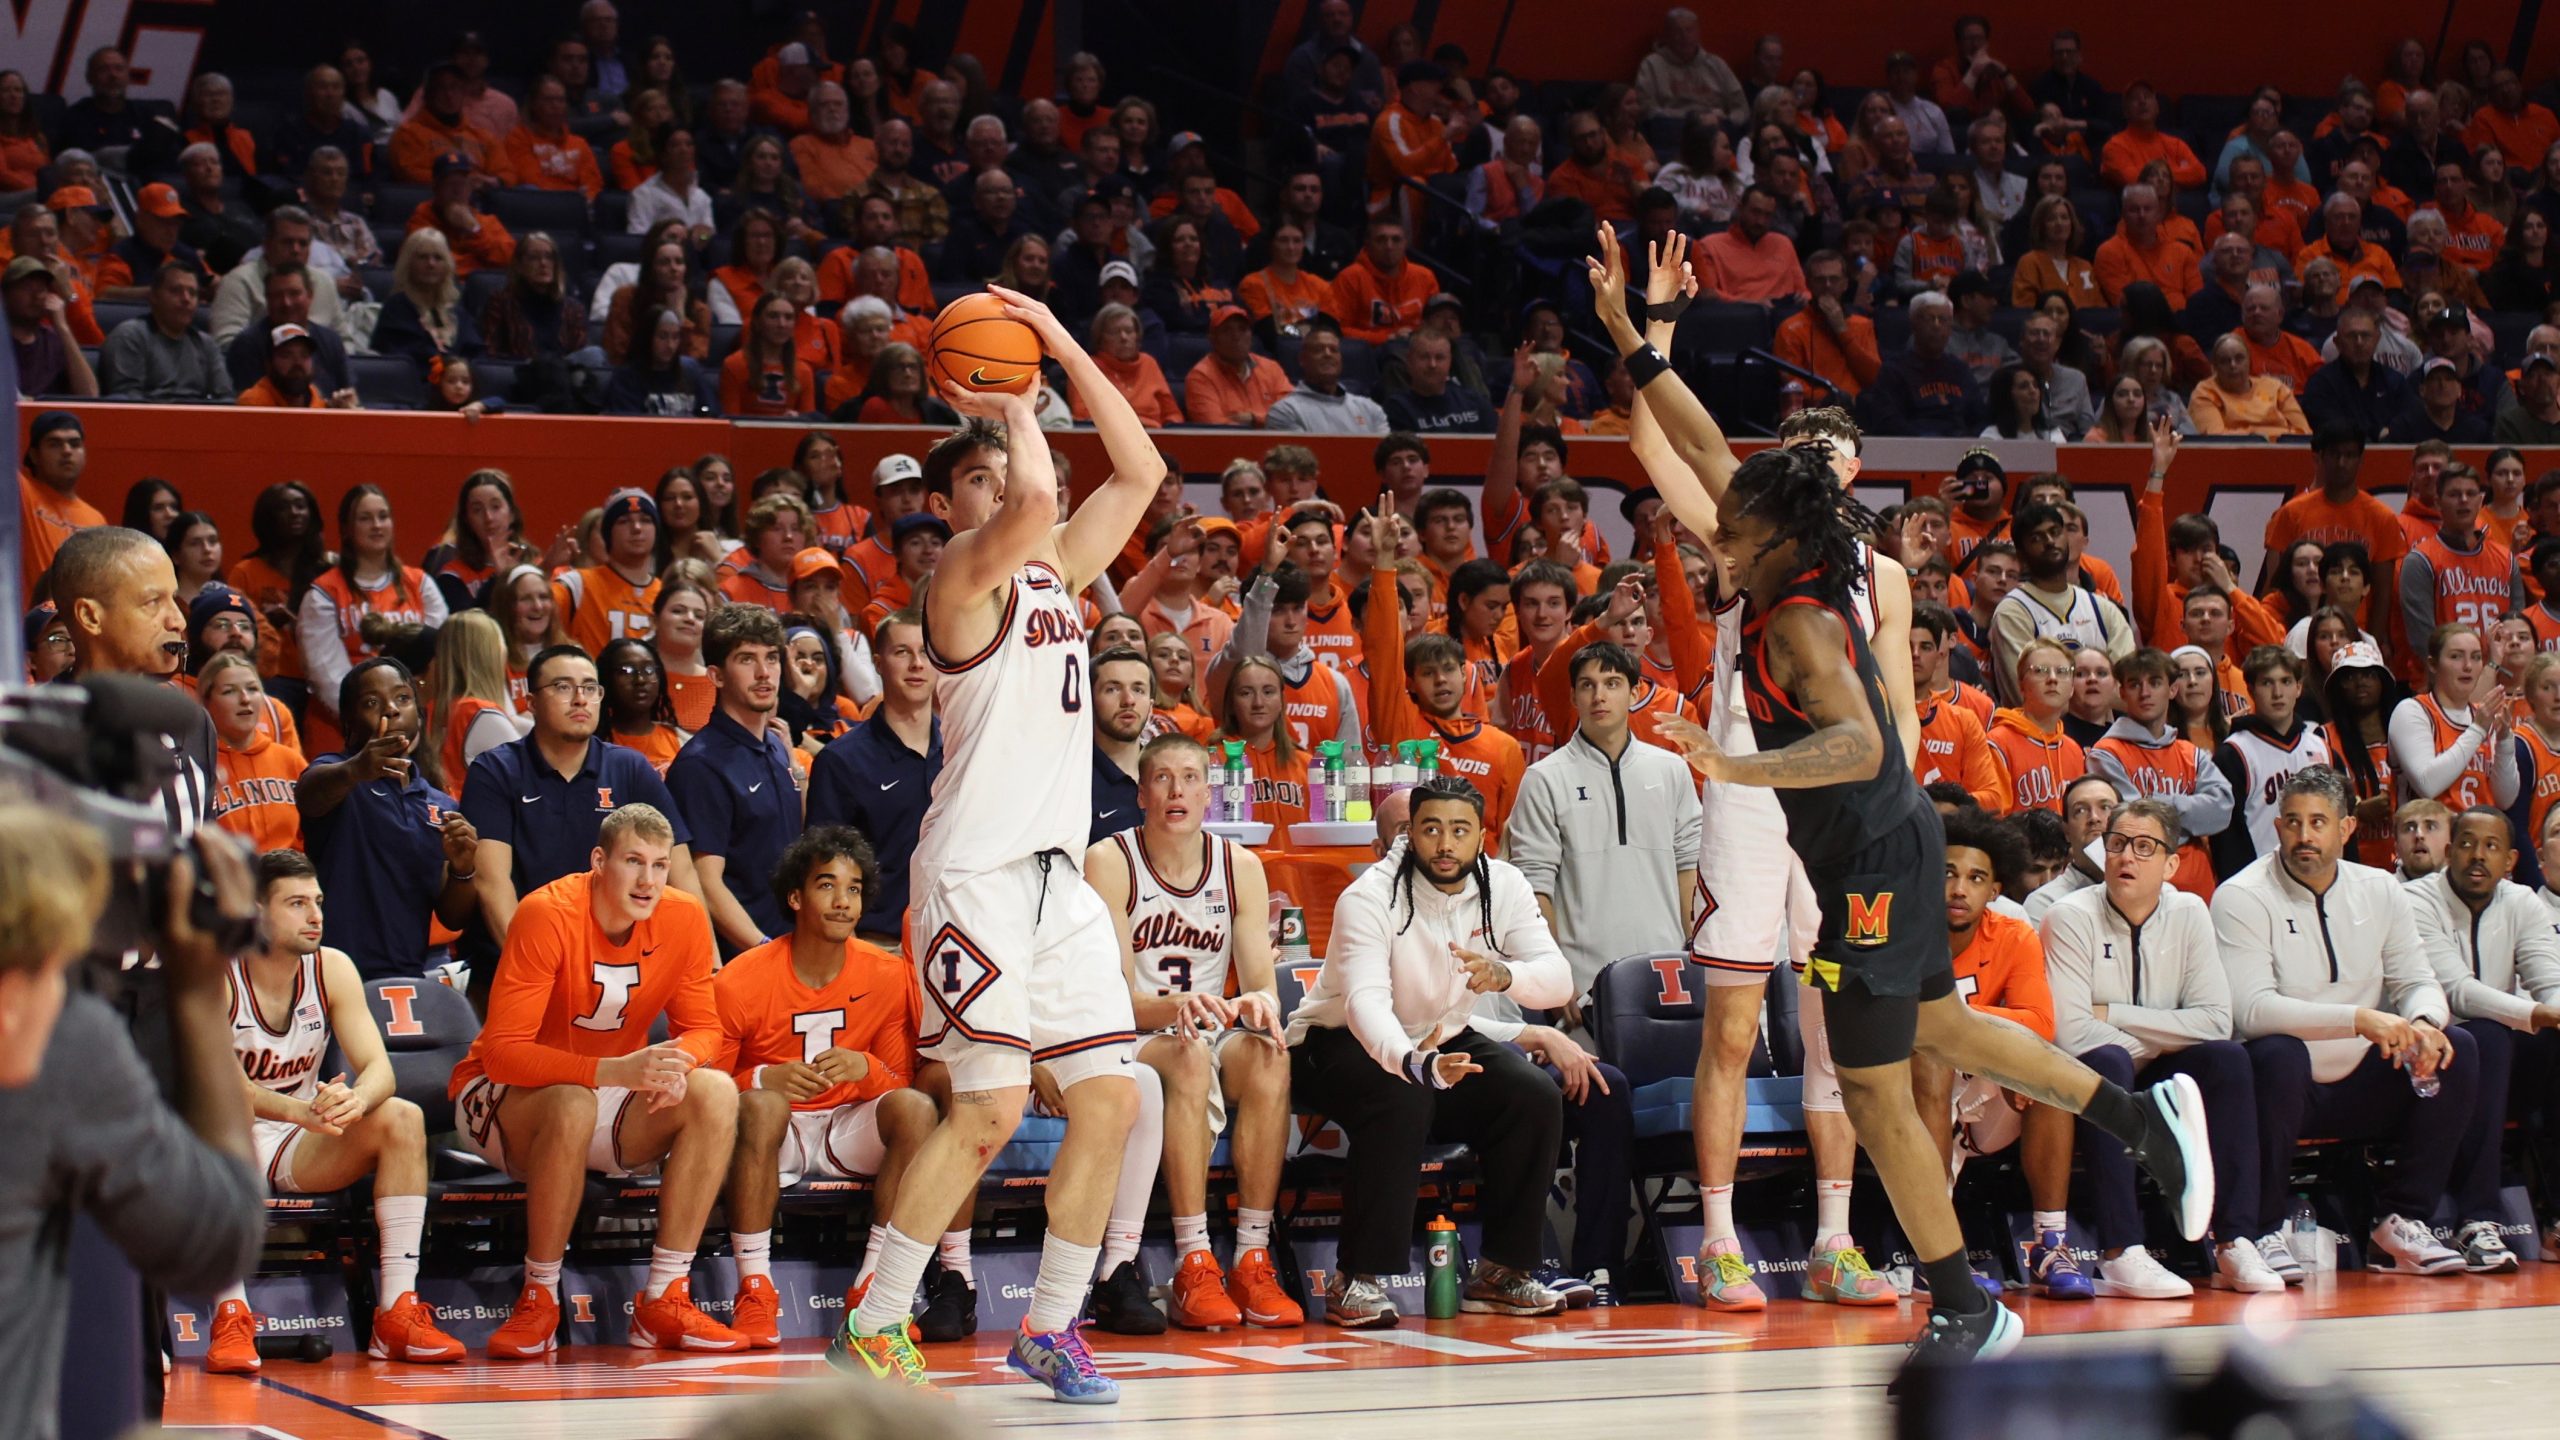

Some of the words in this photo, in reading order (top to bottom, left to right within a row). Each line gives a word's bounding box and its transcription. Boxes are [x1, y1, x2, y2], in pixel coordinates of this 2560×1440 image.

[2441, 566, 2511, 599] Illinois
[1062, 653, 1082, 713] 0
[598, 787, 614, 808] I
[2460, 776, 2480, 808] 6
[427, 804, 442, 825] I
[1845, 892, 1894, 938] M
[1132, 910, 1226, 954] Illinois
[941, 950, 962, 994] I
[1650, 958, 1693, 1006] I
[378, 985, 424, 1037] I
[1759, 1259, 1808, 1274] Busine
[435, 1306, 473, 1321] Gies
[571, 1295, 596, 1323] I
[809, 1295, 845, 1310] Gies
[174, 1313, 200, 1342] I
[267, 1314, 345, 1332] Business
